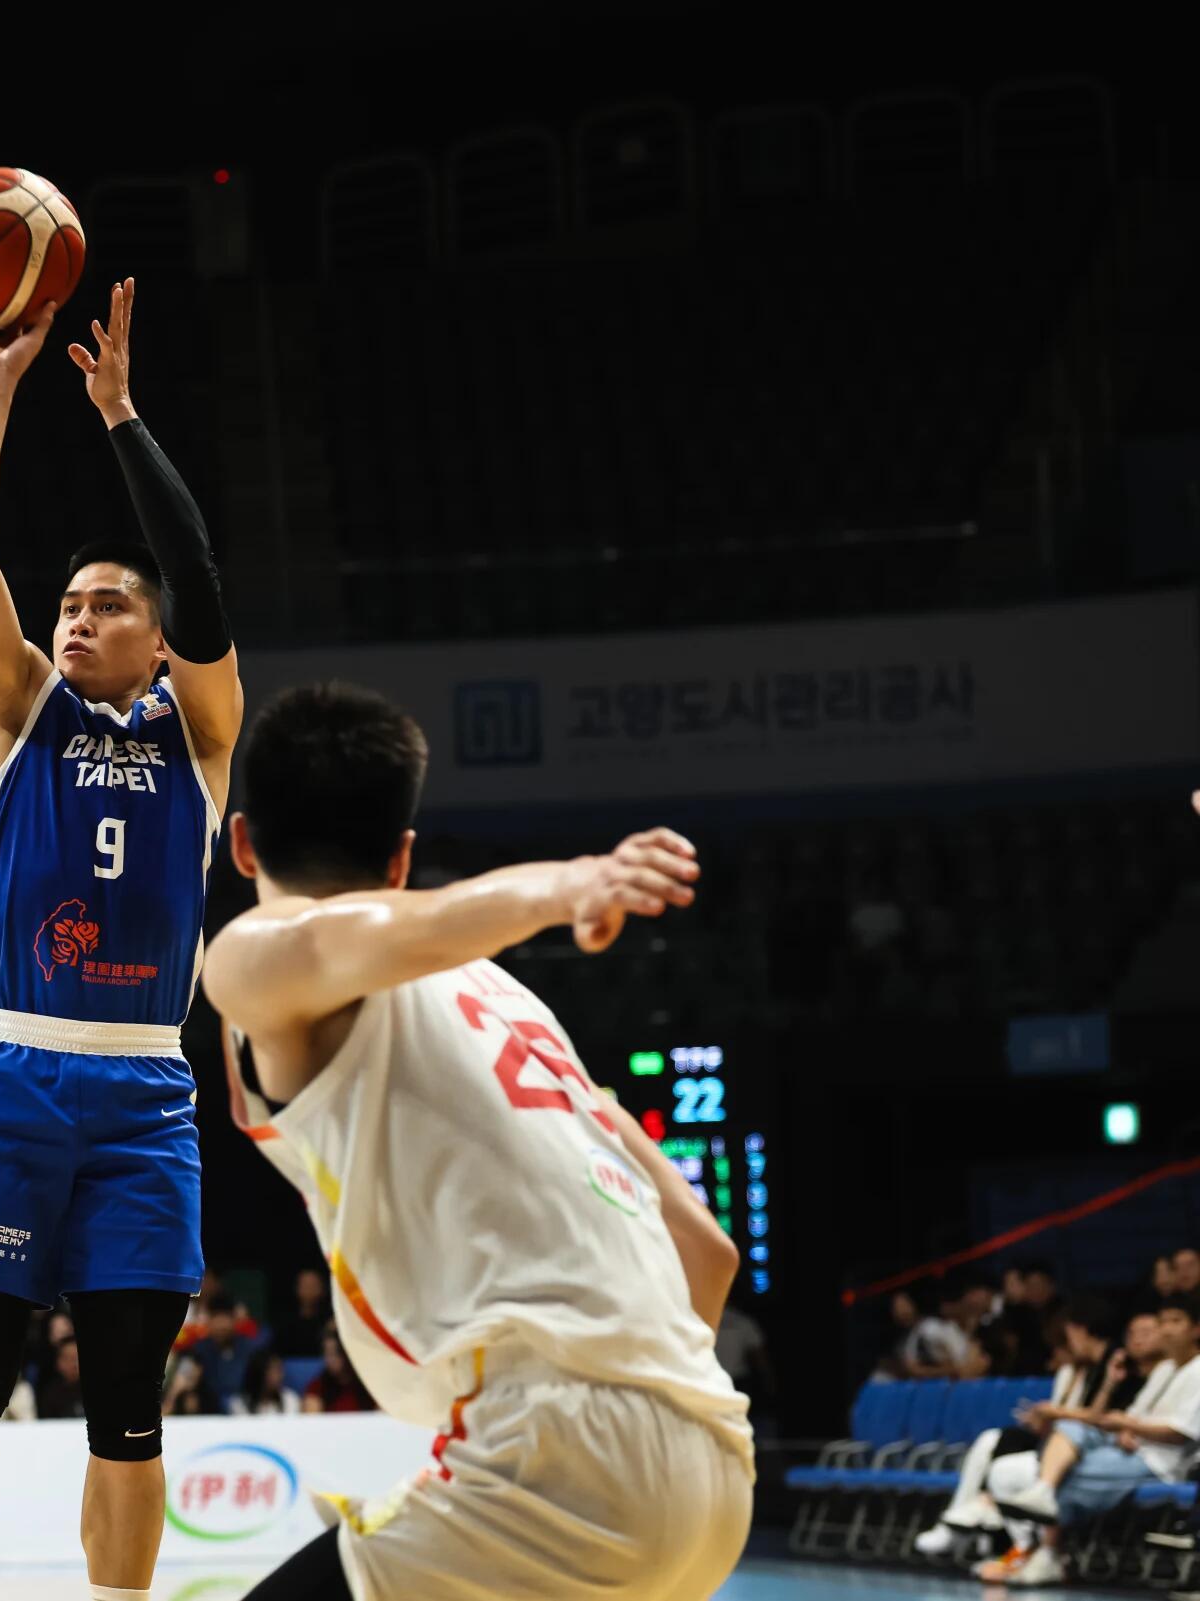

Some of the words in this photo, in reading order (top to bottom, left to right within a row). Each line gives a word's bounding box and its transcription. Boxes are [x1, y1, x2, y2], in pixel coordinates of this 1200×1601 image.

[63, 734, 166, 767] CHNESE
[94, 817, 126, 879] 9
[672, 1076, 727, 1124] 22
